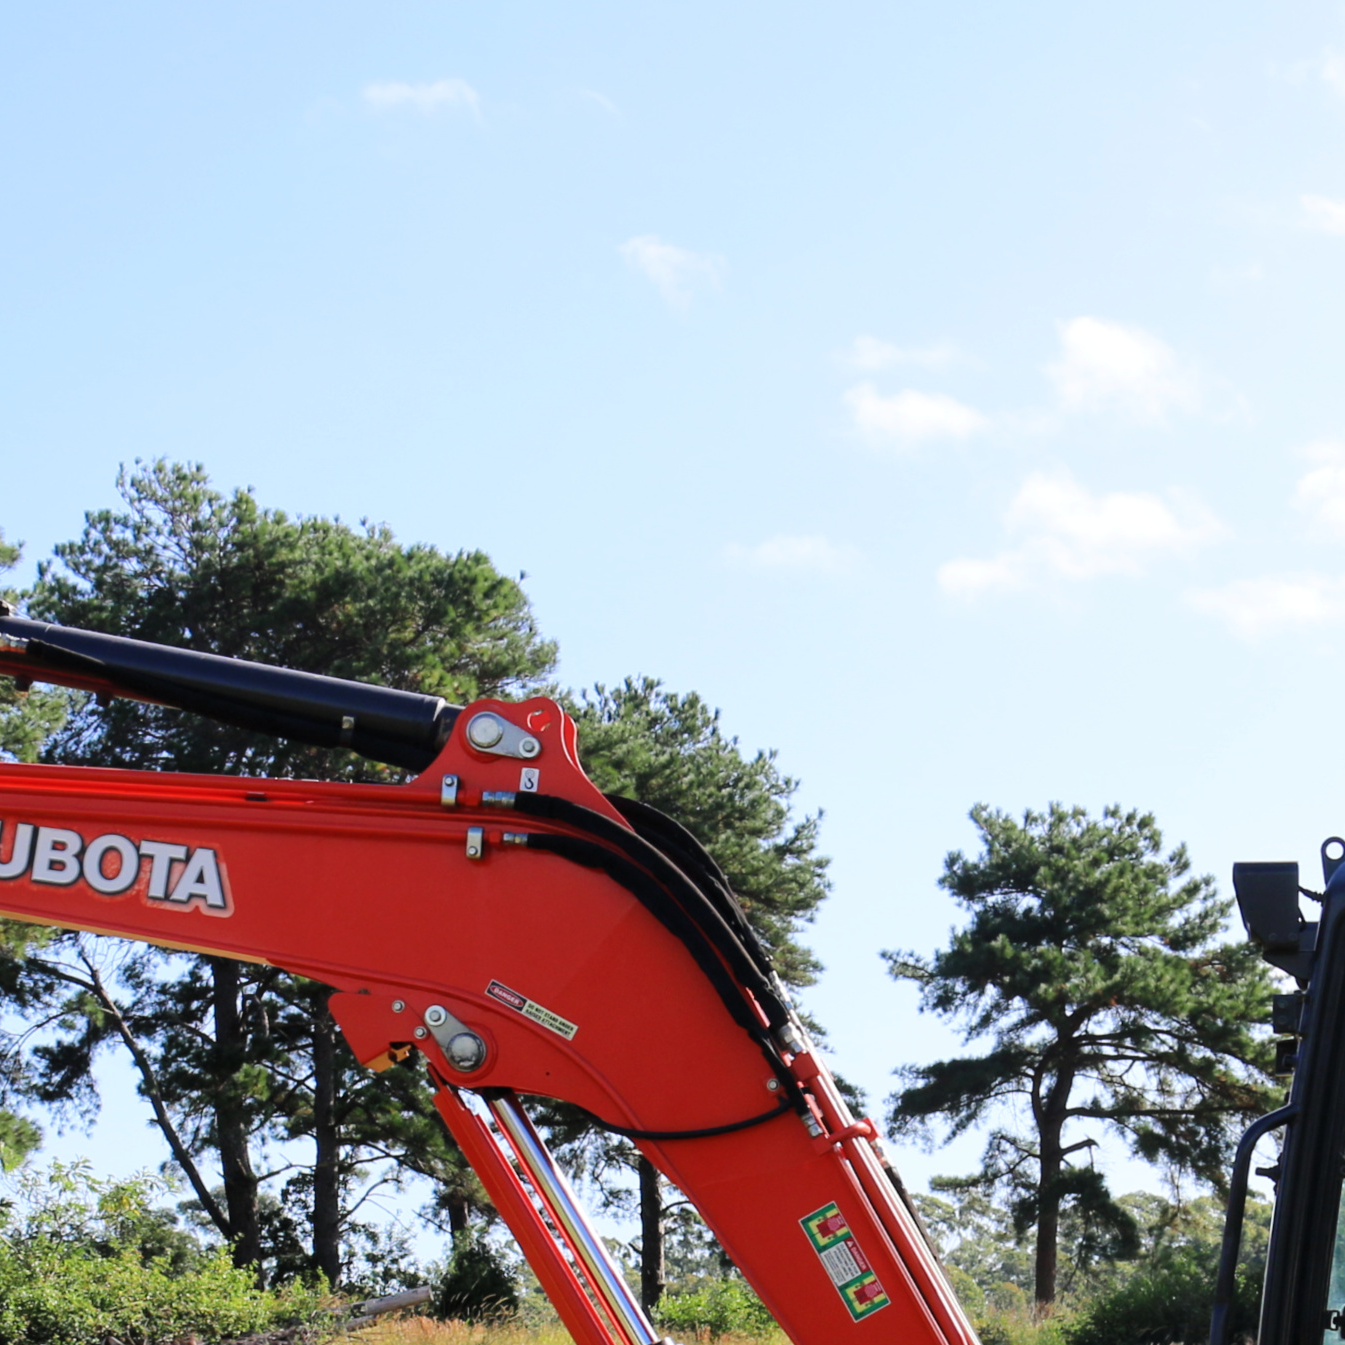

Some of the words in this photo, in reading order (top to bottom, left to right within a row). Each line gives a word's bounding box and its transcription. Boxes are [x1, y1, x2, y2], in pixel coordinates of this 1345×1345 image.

[494, 987, 520, 1004] DANGER
[535, 1007, 544, 1015] NOT
[544, 1012, 559, 1023] STAND
